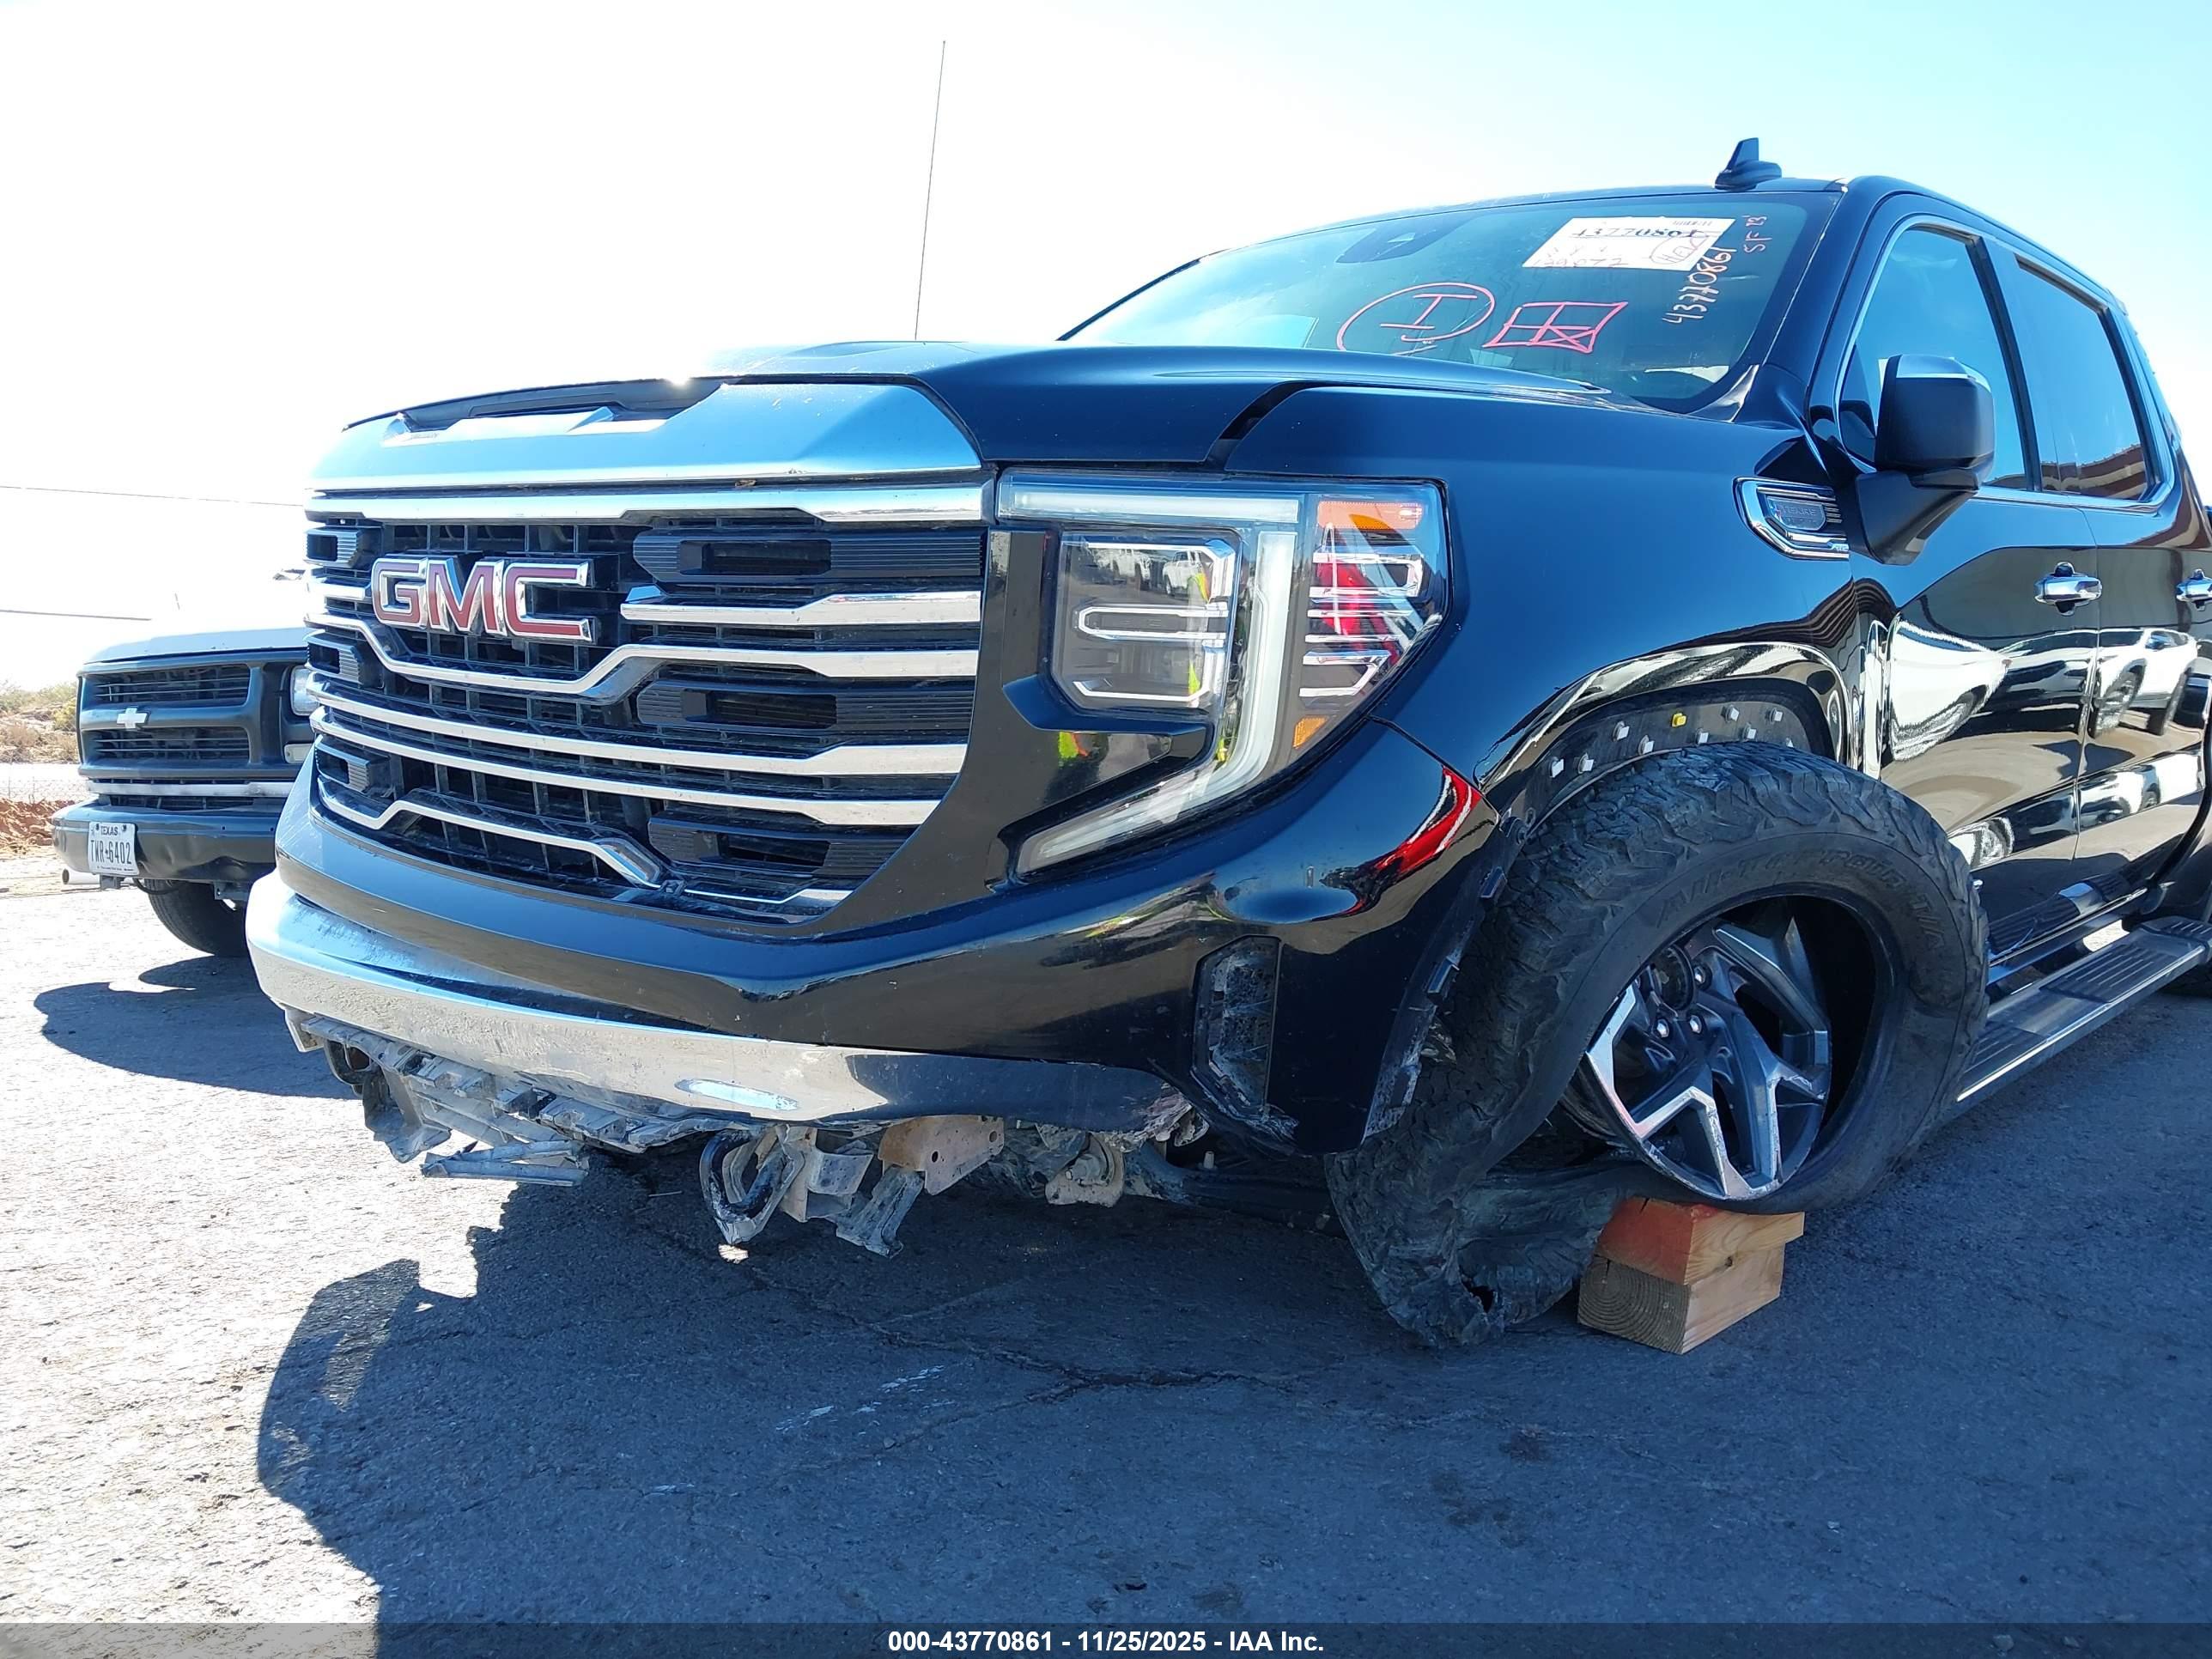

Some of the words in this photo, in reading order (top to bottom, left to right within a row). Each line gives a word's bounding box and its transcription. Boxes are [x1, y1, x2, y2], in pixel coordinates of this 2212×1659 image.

[1662, 246, 1737, 323] 43770861
[371, 557, 592, 642] GMC
[100, 826, 118, 836] TEXAS
